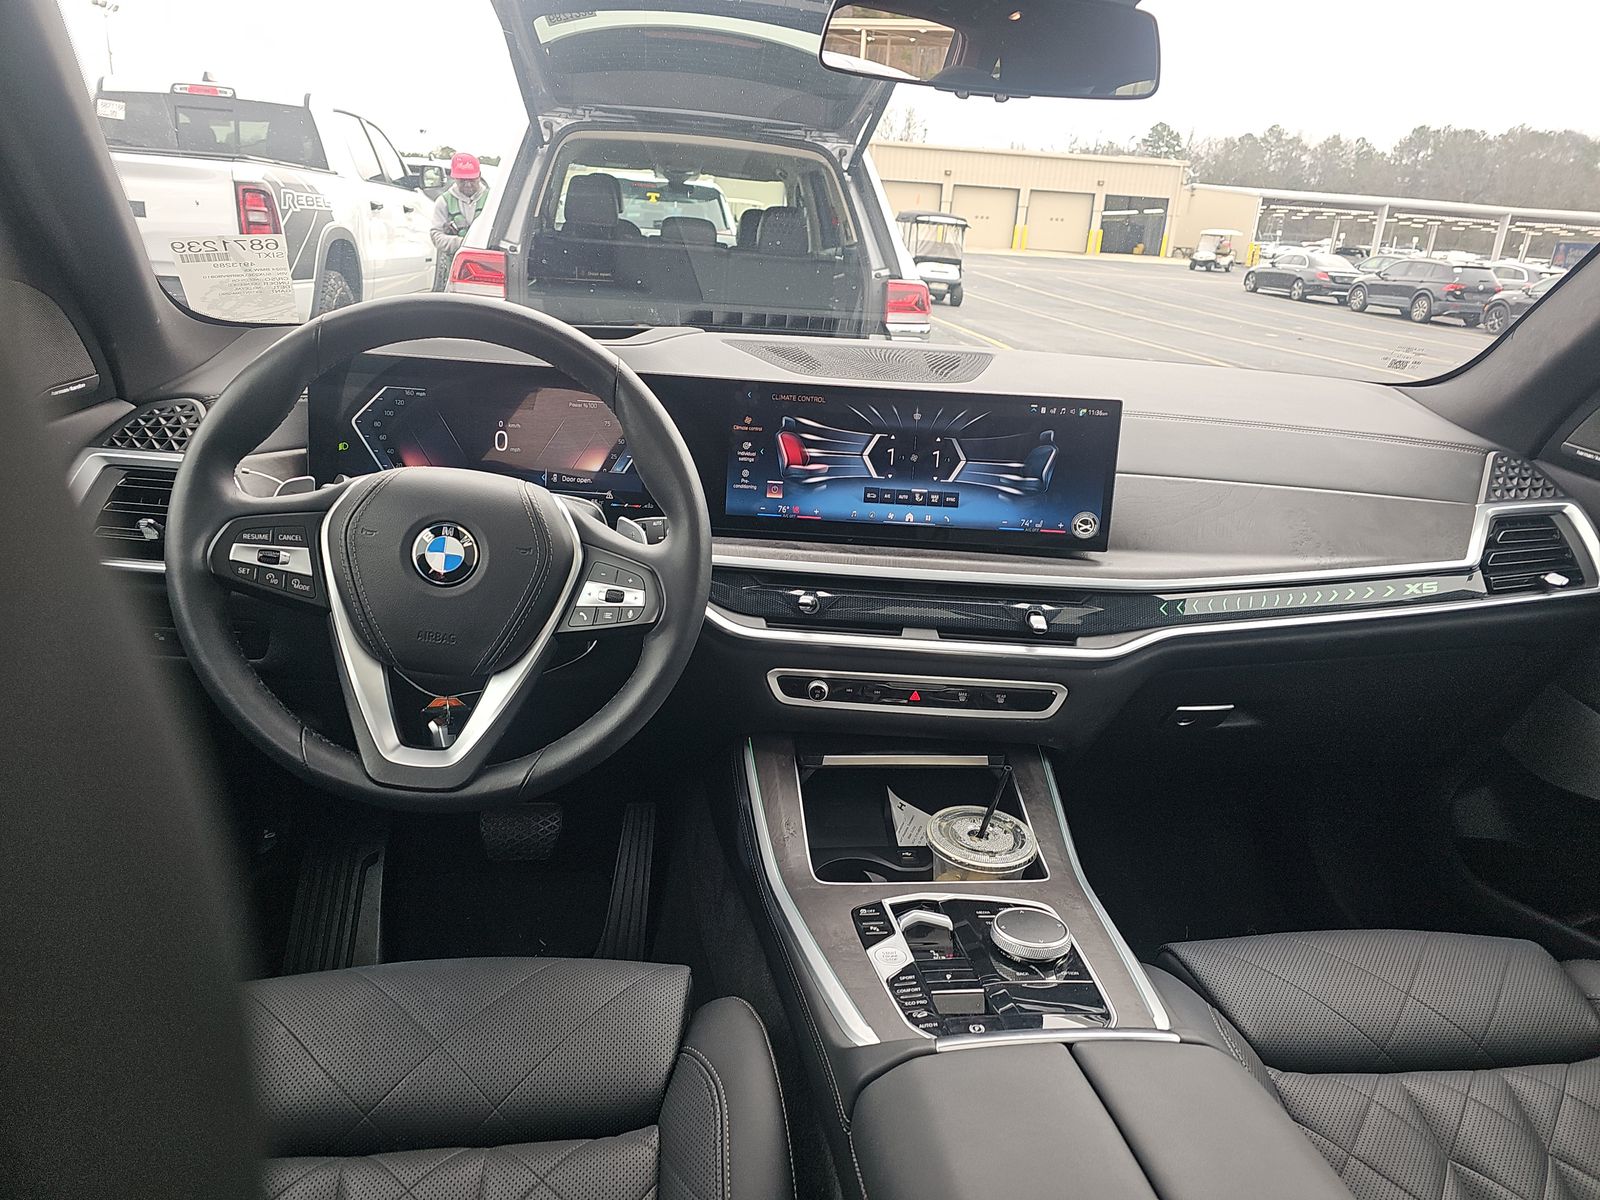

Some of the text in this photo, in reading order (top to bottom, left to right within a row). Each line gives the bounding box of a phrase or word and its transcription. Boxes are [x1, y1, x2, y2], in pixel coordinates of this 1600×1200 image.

[280, 188, 332, 211] REBEL
[771, 393, 826, 403] CLIMATE CONTROL
[495, 430, 508, 451] 0
[887, 448, 894, 466] 1
[932, 450, 940, 468] 1
[561, 475, 576, 483] Door
[778, 505, 789, 513] 76°
[1021, 519, 1032, 527] 74°
[422, 526, 473, 548] BMW
[1403, 581, 1438, 596] X5
[417, 631, 457, 645] AIRBAG
